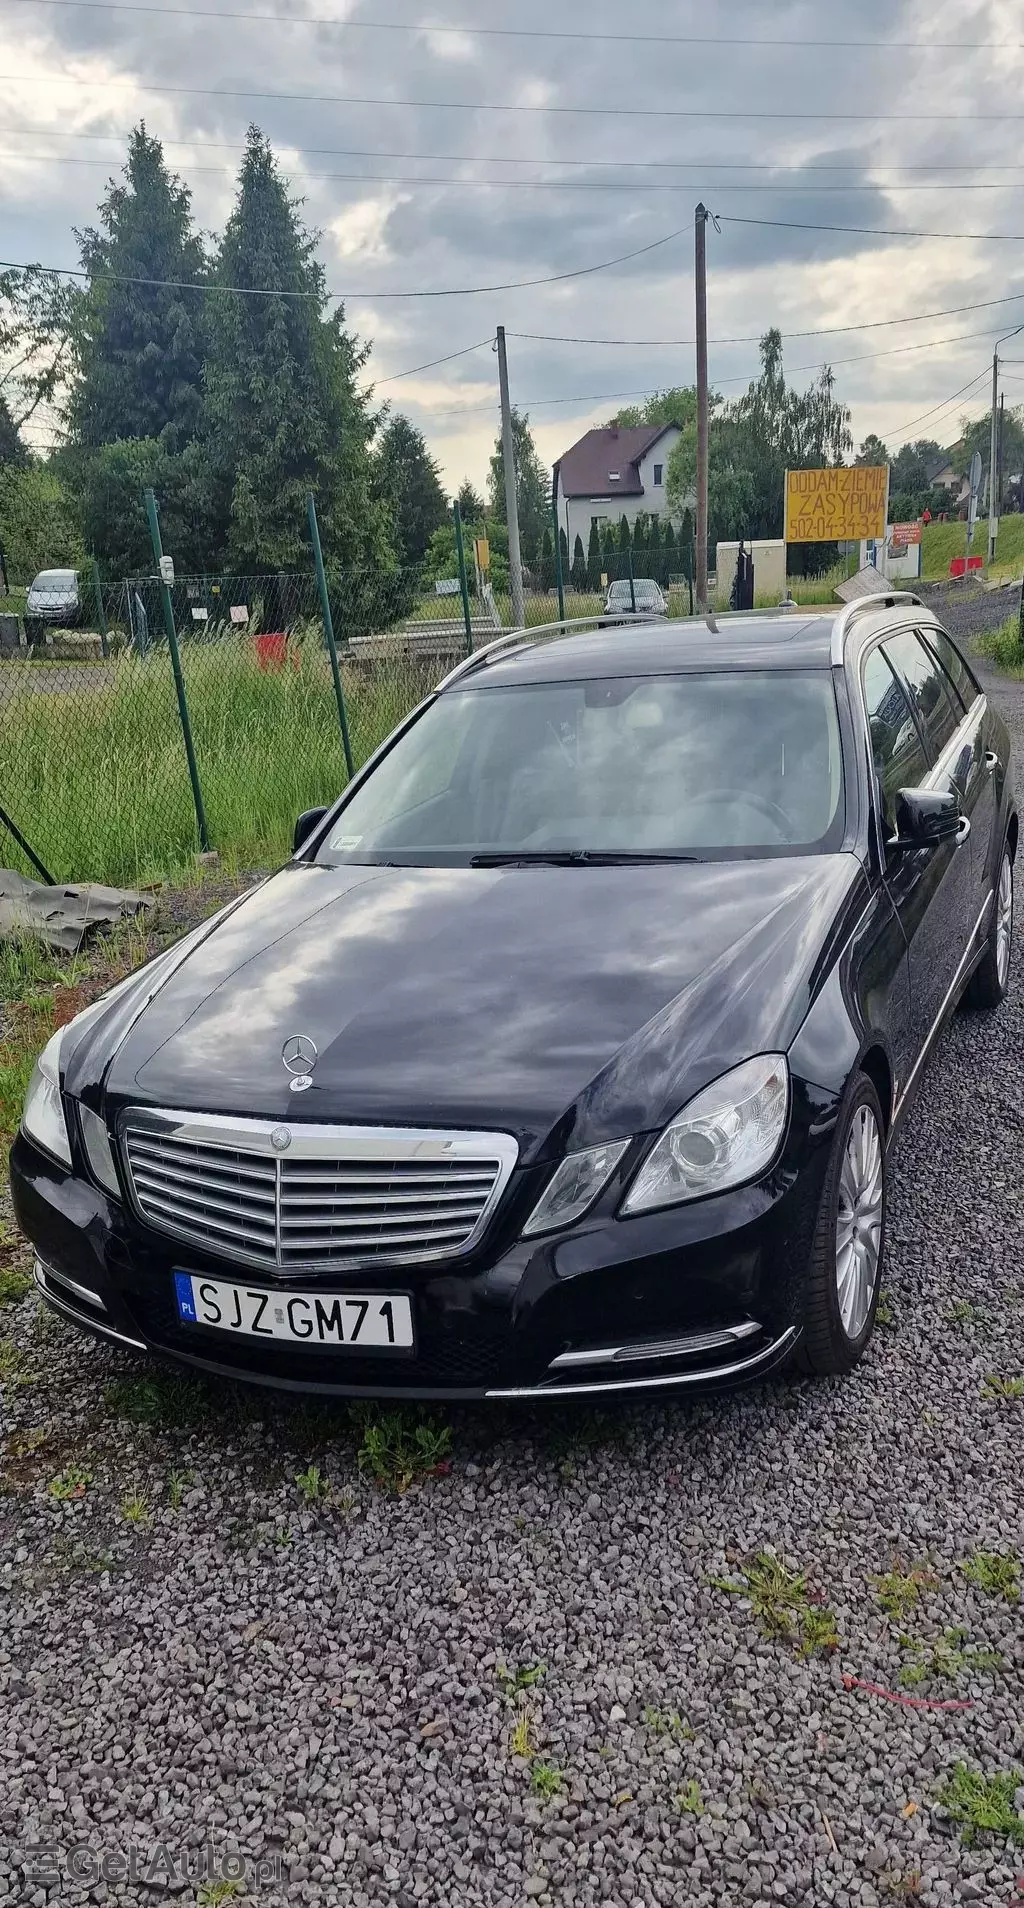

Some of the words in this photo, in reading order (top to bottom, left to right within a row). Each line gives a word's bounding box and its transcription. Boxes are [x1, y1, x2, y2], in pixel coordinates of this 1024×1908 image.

[790, 515, 880, 539] 502-04-34-34
[181, 1302, 194, 1316] PL
[199, 1283, 273, 1334] SJZ
[286, 1297, 395, 1343] GM71
